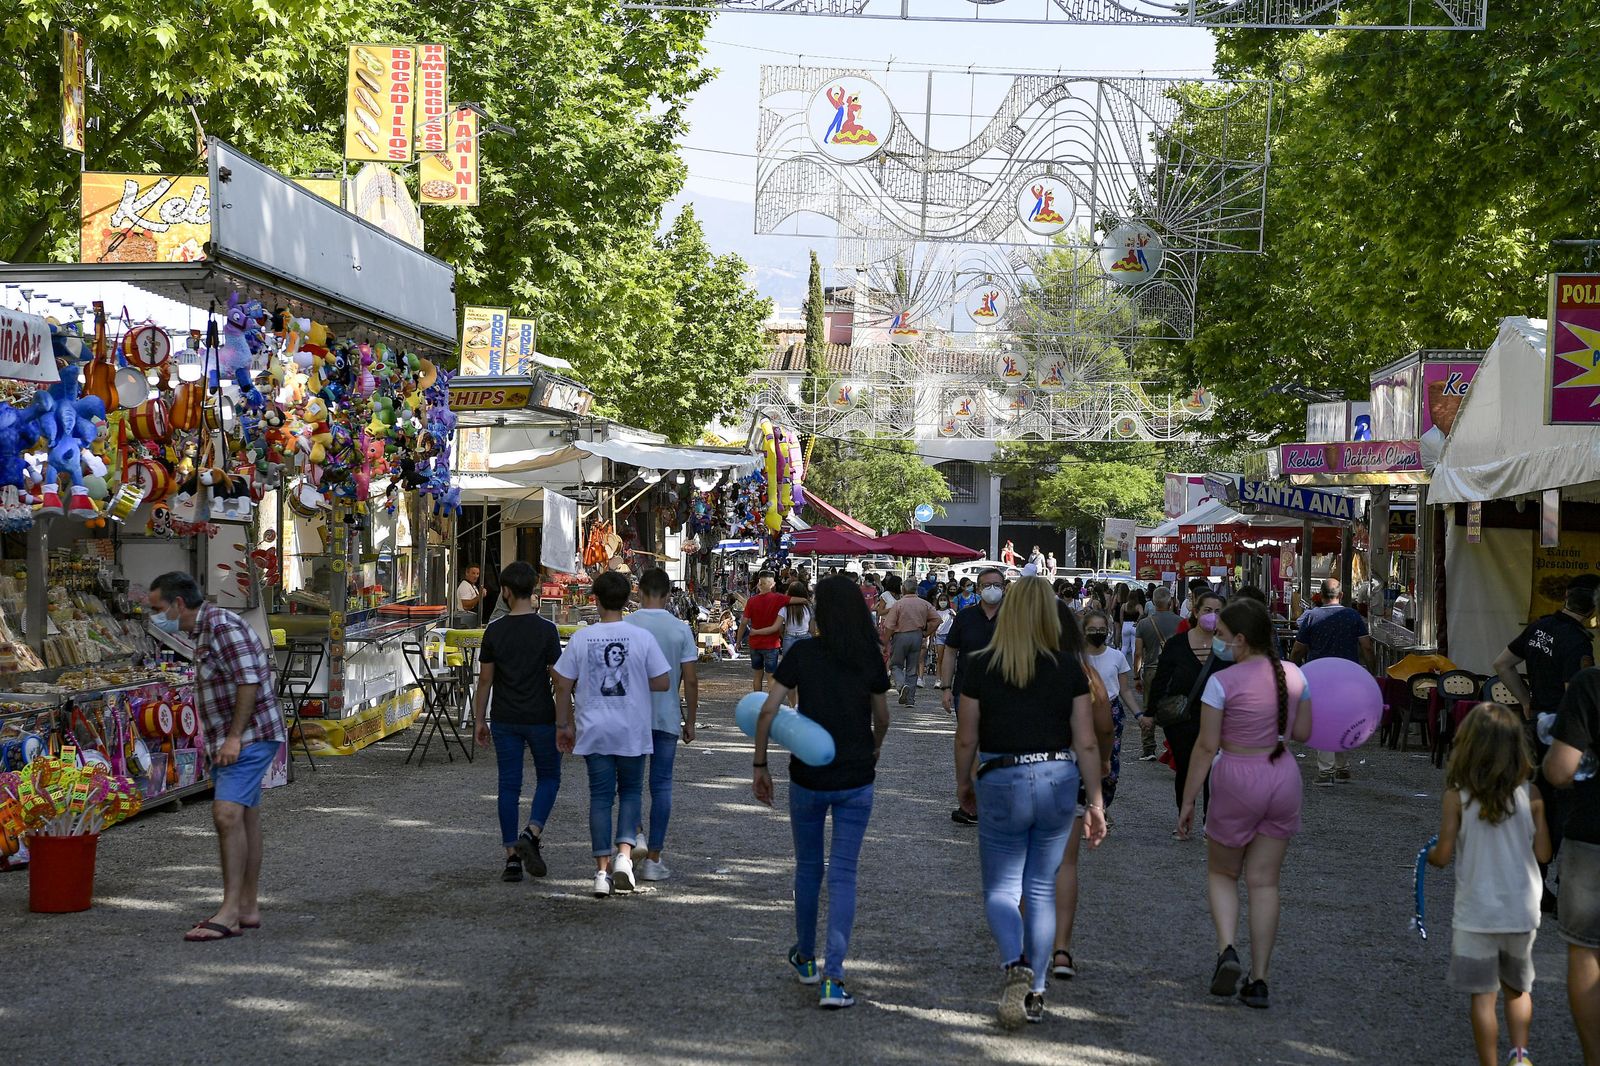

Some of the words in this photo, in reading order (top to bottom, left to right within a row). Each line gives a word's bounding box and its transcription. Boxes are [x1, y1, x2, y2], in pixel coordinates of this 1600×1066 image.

[388, 49, 411, 160] BOCADILLOS
[421, 45, 446, 150] HAMBURGUESAS
[455, 109, 472, 200] PANINI
[1286, 449, 1324, 468] Kebab
[1343, 445, 1383, 468] Patatas
[1385, 445, 1417, 469] Chips
[1243, 484, 1305, 510] SANTA
[1308, 493, 1350, 518] ANA
[1181, 532, 1233, 544] HAMBURGUESA
